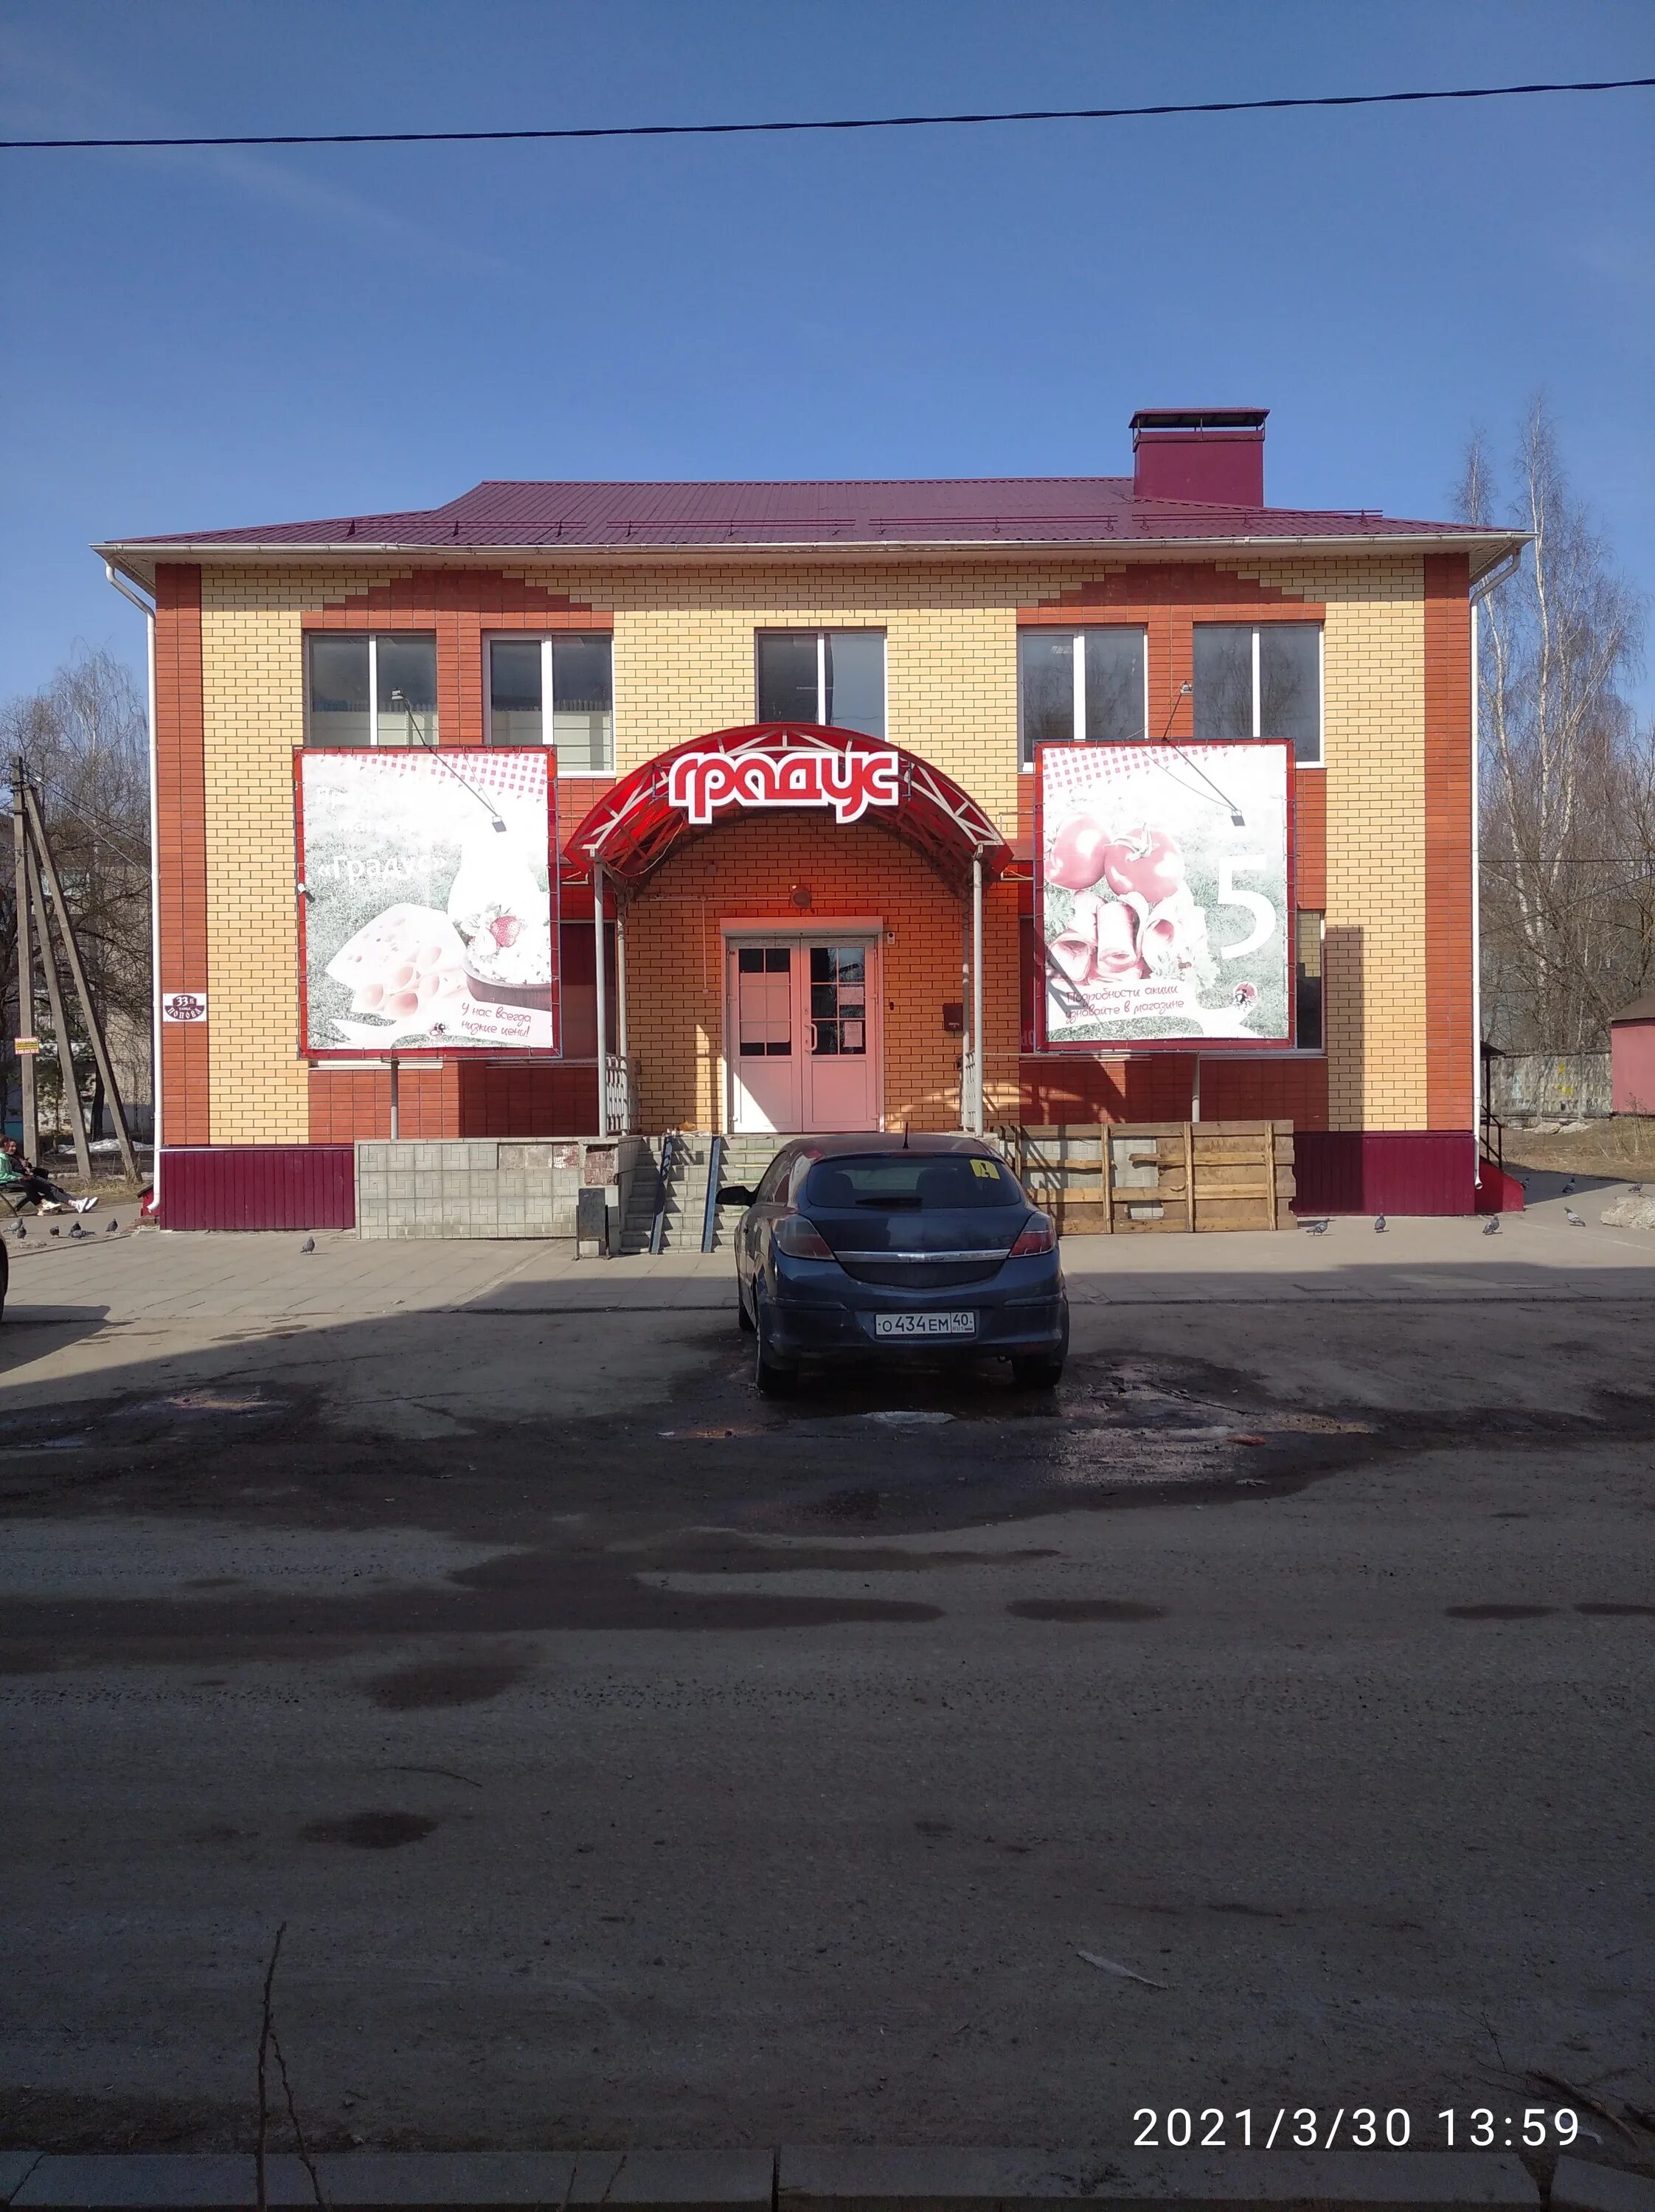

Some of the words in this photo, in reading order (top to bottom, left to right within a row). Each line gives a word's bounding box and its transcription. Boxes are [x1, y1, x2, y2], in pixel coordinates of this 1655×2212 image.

[1218, 855, 1276, 959] 5
[176, 997, 189, 1006] 33
[1066, 987, 1140, 1007] Подробности
[1145, 986, 1179, 995] акции
[167, 1007, 201, 1019] ПОПОВА
[462, 1003, 470, 1016] У
[472, 1007, 492, 1018] нас
[496, 1006, 531, 1027] всегда
[1066, 1004, 1120, 1024] узнавайте
[1124, 1001, 1131, 1012] в
[1134, 1001, 1184, 1015] магазине
[461, 1020, 497, 1035] низкие
[501, 1026, 530, 1037] цены!
[953, 1314, 968, 1326] 40
